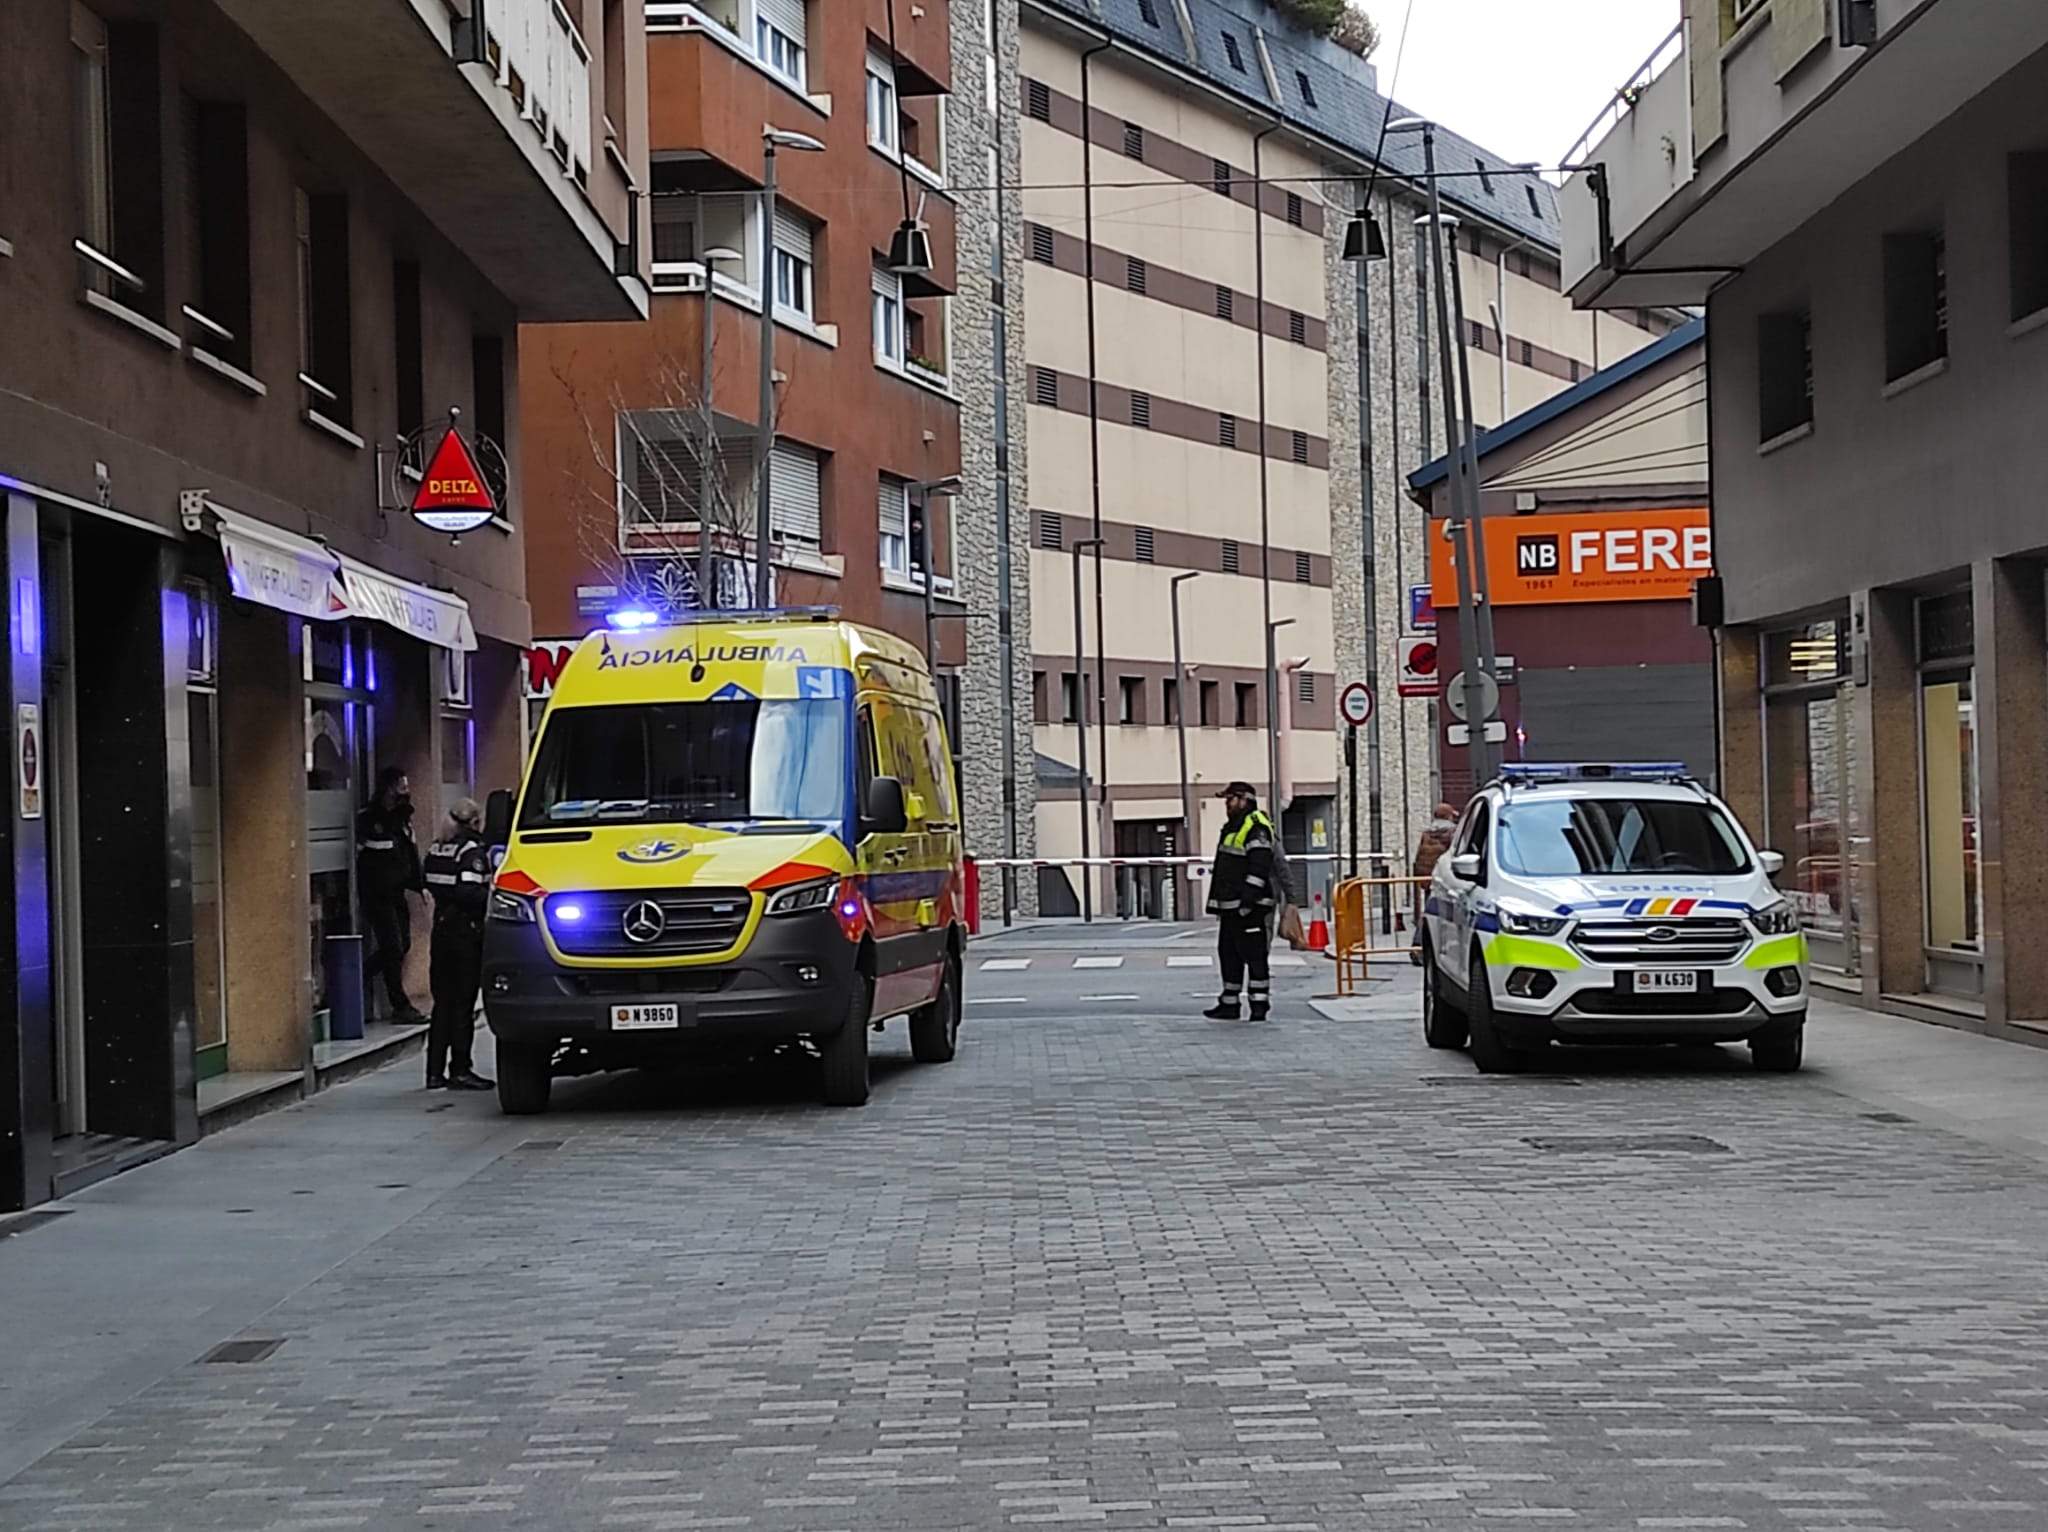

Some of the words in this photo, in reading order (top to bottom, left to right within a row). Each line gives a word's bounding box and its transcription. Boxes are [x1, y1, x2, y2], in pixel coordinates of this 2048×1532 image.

[429, 480, 479, 494] DELTA
[1519, 544, 1557, 569] NB
[1570, 527, 1712, 573] FERB
[1655, 973, 1662, 986] N
[1664, 972, 1694, 986] 4630
[633, 1008, 641, 1022] N
[643, 1007, 674, 1022] 9860
